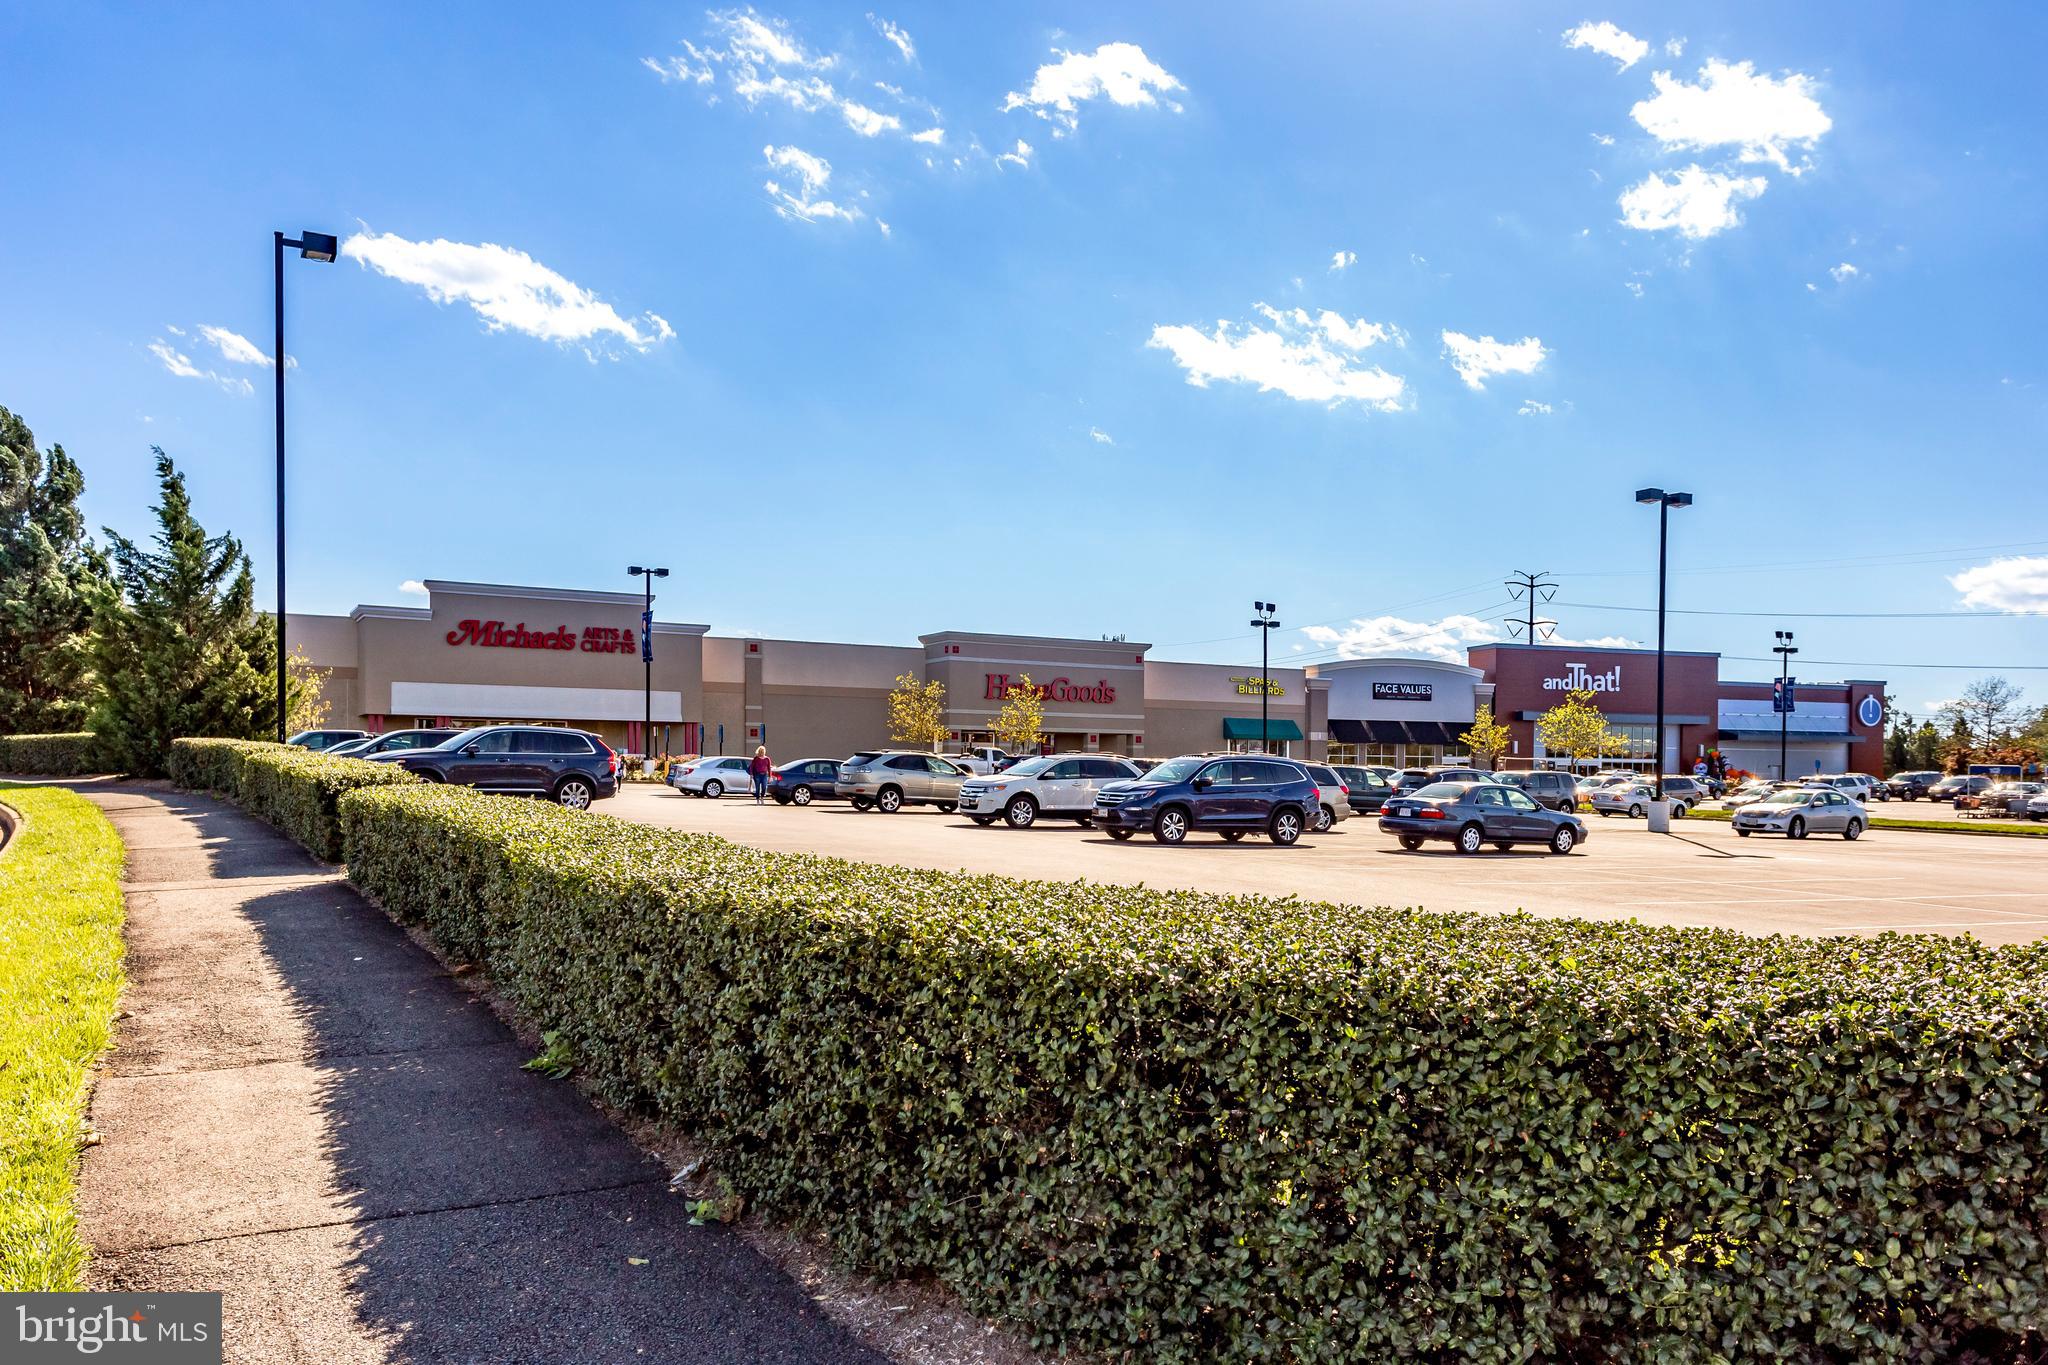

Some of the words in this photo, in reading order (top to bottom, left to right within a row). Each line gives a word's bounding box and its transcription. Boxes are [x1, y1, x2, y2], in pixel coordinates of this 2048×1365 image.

[446, 619, 577, 651] Michaels
[582, 626, 620, 641] ARTS
[622, 628, 634, 642] &
[580, 639, 636, 654] CRAFTS
[1375, 683, 1399, 693] FACE
[1399, 684, 1432, 695] VALUES
